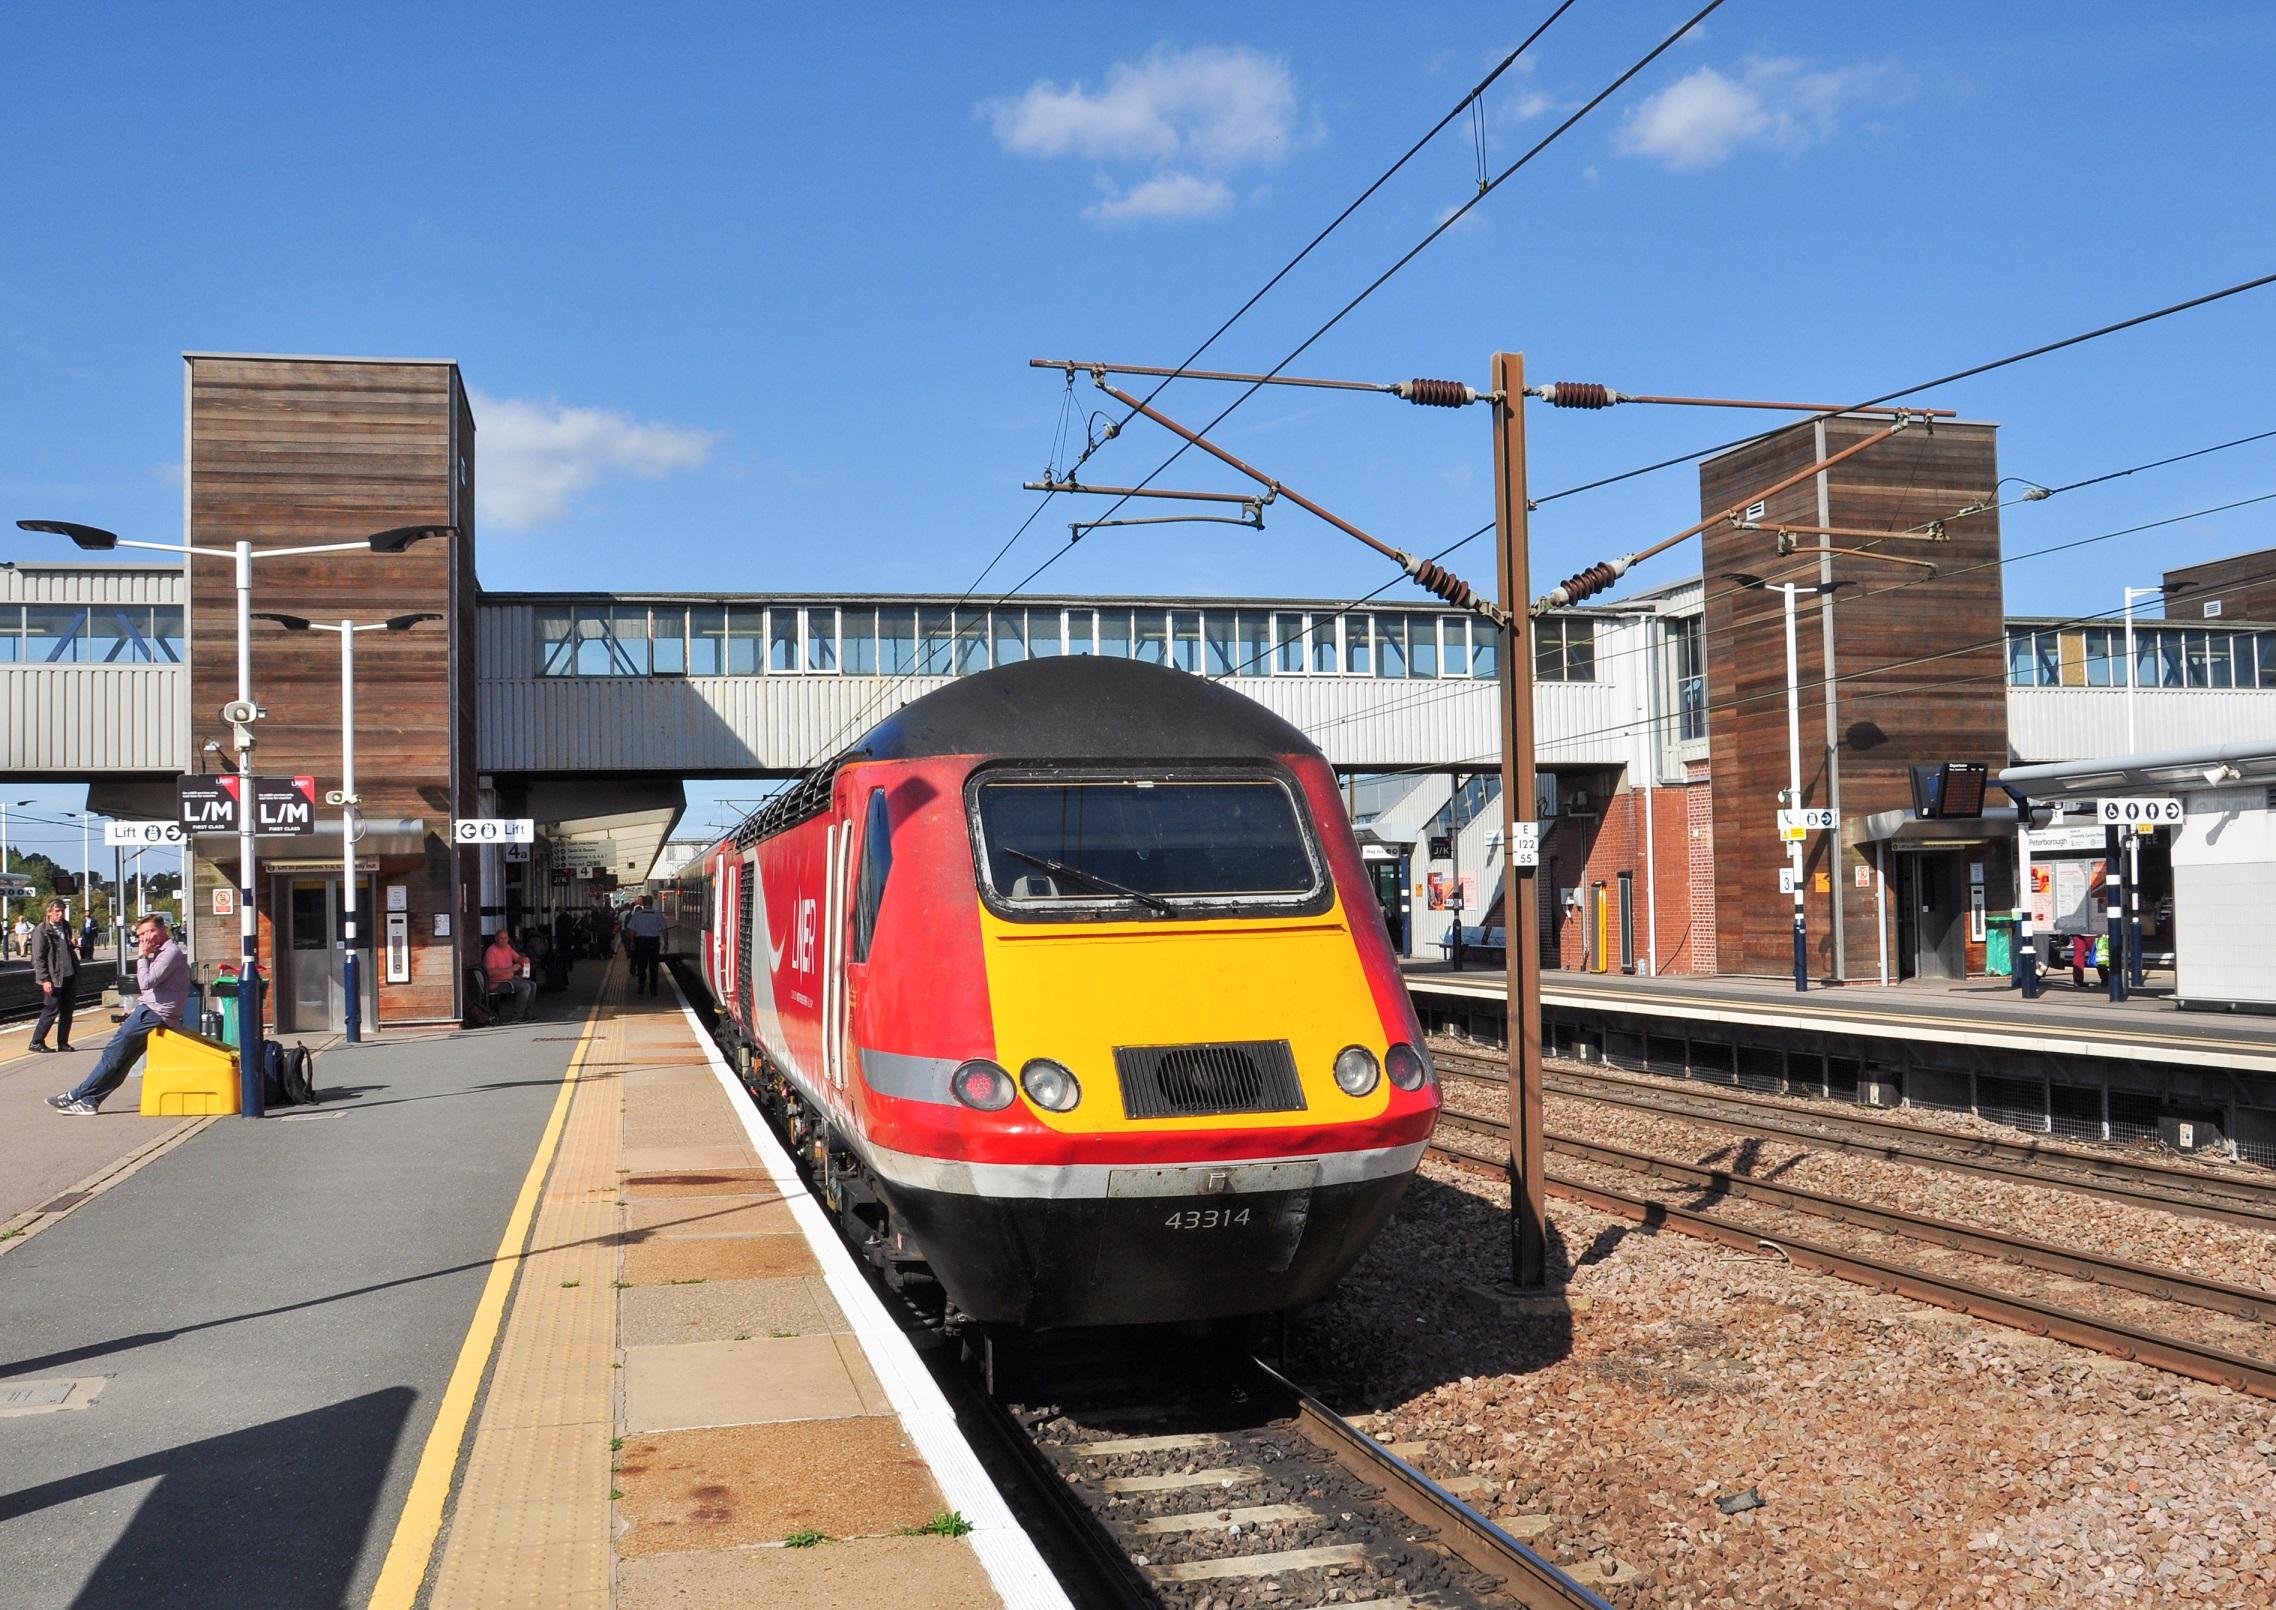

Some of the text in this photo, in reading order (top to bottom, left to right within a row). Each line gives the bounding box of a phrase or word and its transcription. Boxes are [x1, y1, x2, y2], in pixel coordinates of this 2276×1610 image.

[184, 801, 233, 821] L/M
[260, 803, 308, 824] L/M
[115, 827, 136, 838] Lift
[504, 824, 525, 835] Lift
[1523, 825, 1529, 834] E
[1519, 839, 1535, 849] 122
[2028, 837, 2067, 847] Peterborough
[508, 844, 528, 859] 4a
[1433, 847, 1450, 855] J/K
[1520, 854, 1532, 864] 55
[580, 867, 589, 876] 4
[1784, 877, 1790, 891] 3
[791, 884, 817, 985] LNER
[1164, 1207, 1251, 1230] 43314
